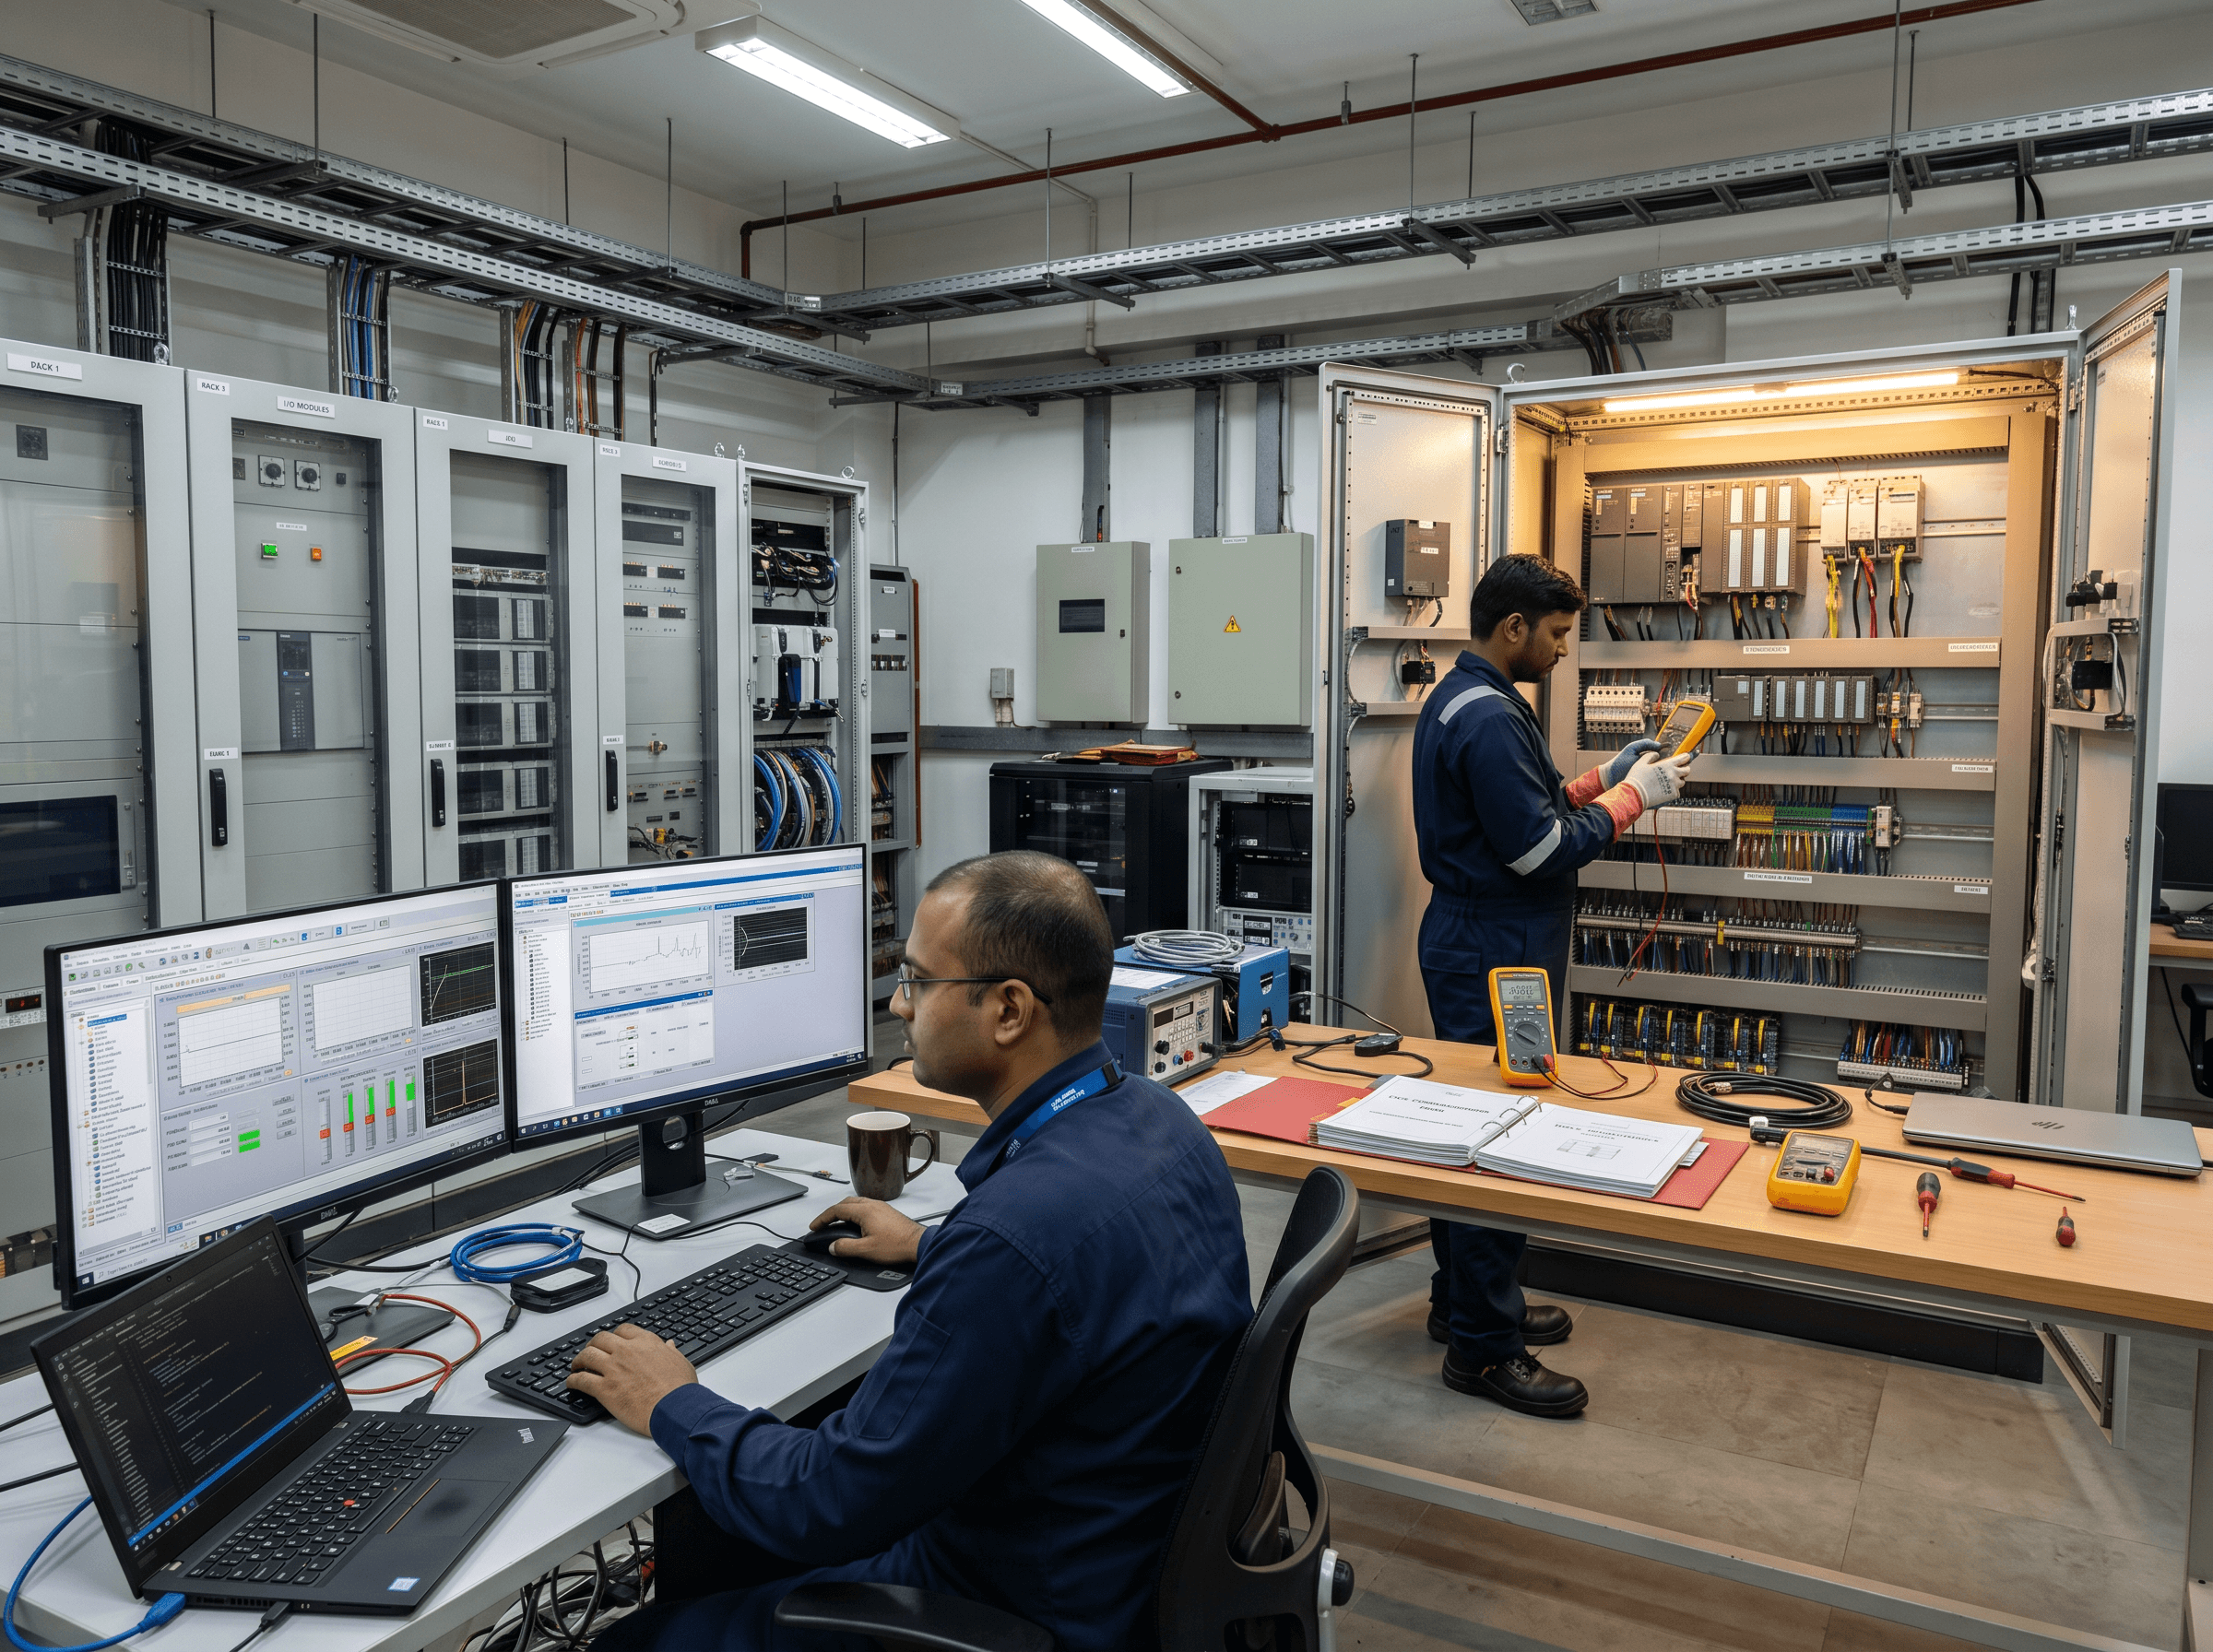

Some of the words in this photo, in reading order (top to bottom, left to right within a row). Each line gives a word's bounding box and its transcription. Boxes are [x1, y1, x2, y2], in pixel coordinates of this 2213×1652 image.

[202, 383, 219, 392] RACK
[284, 400, 294, 408] I/O
[297, 403, 329, 413] MODULES
